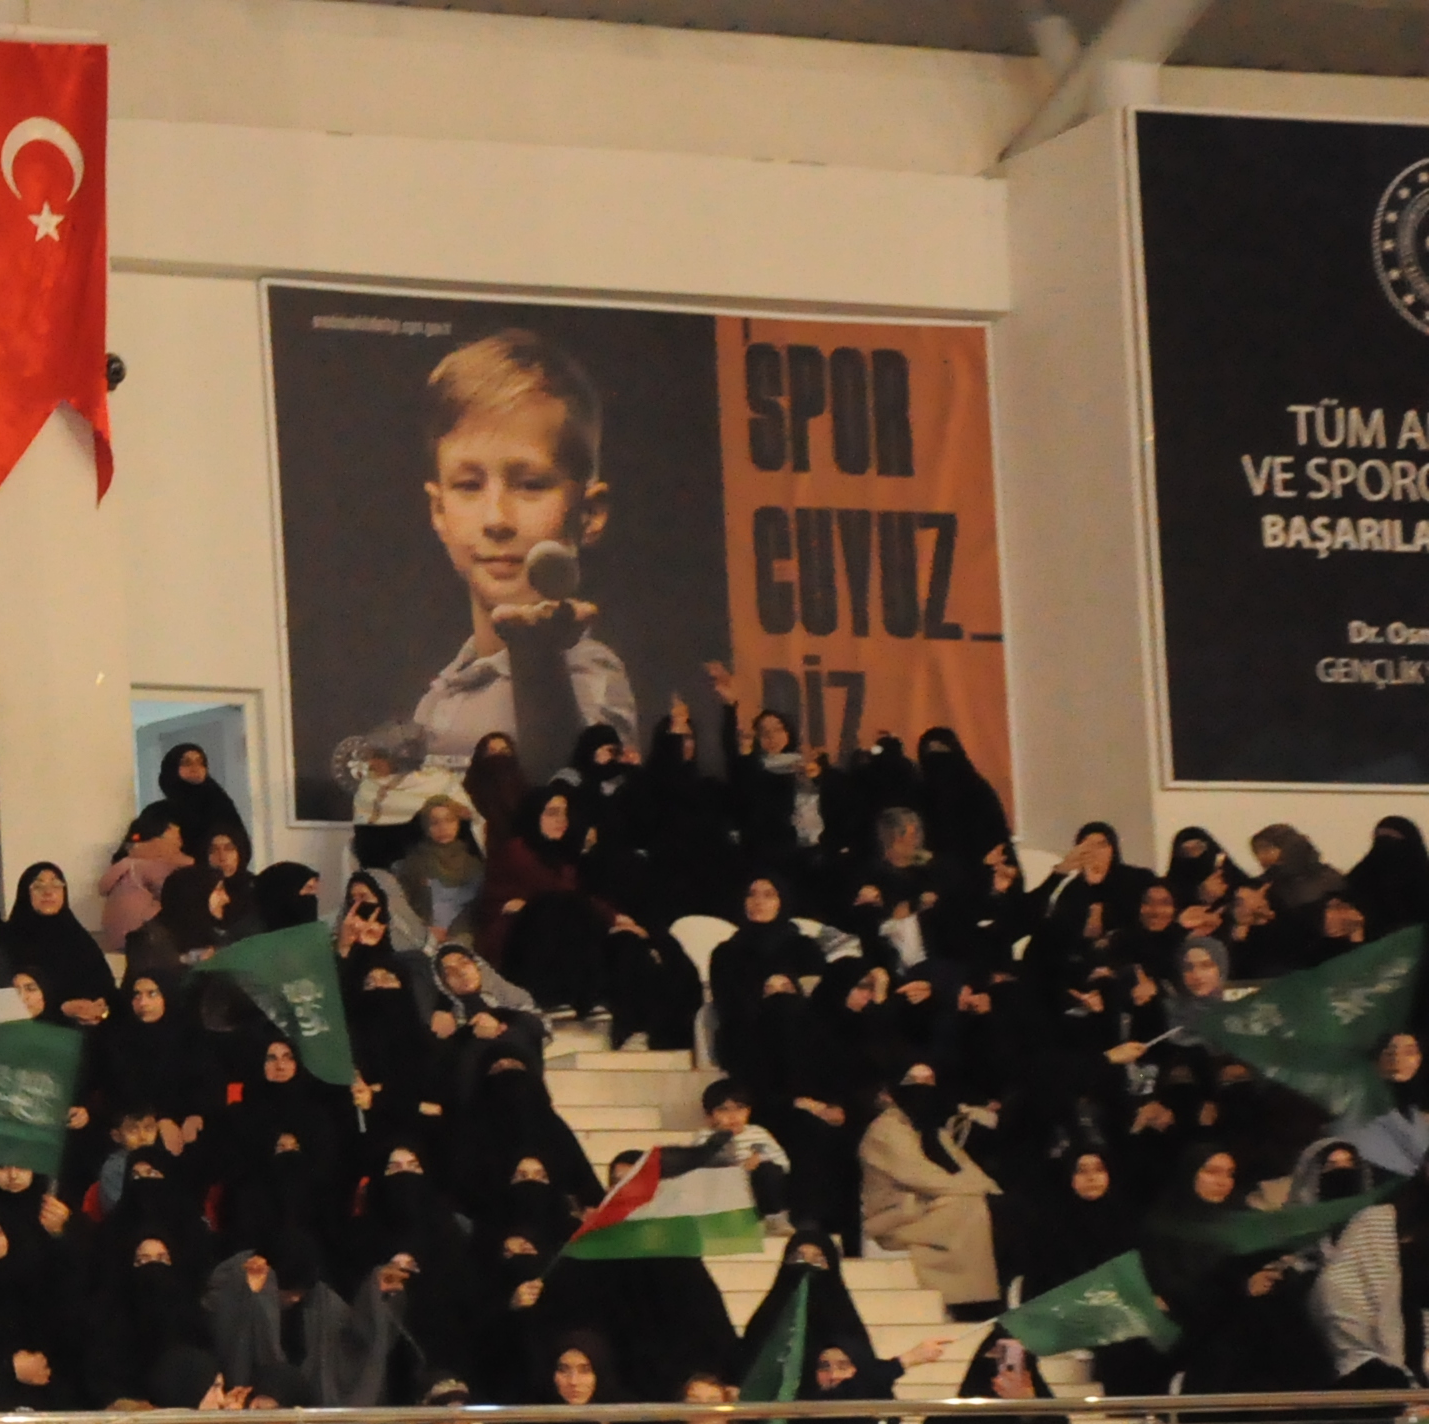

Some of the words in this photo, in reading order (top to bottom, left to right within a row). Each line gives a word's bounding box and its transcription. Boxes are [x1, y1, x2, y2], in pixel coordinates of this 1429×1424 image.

[745, 342, 915, 477] SPOR
[1286, 398, 1387, 449] TÜM
[1397, 408, 1429, 450] A
[1241, 453, 1298, 498] VE
[1348, 619, 1386, 645] Dr.
[1315, 655, 1425, 691] GENÇLİK
